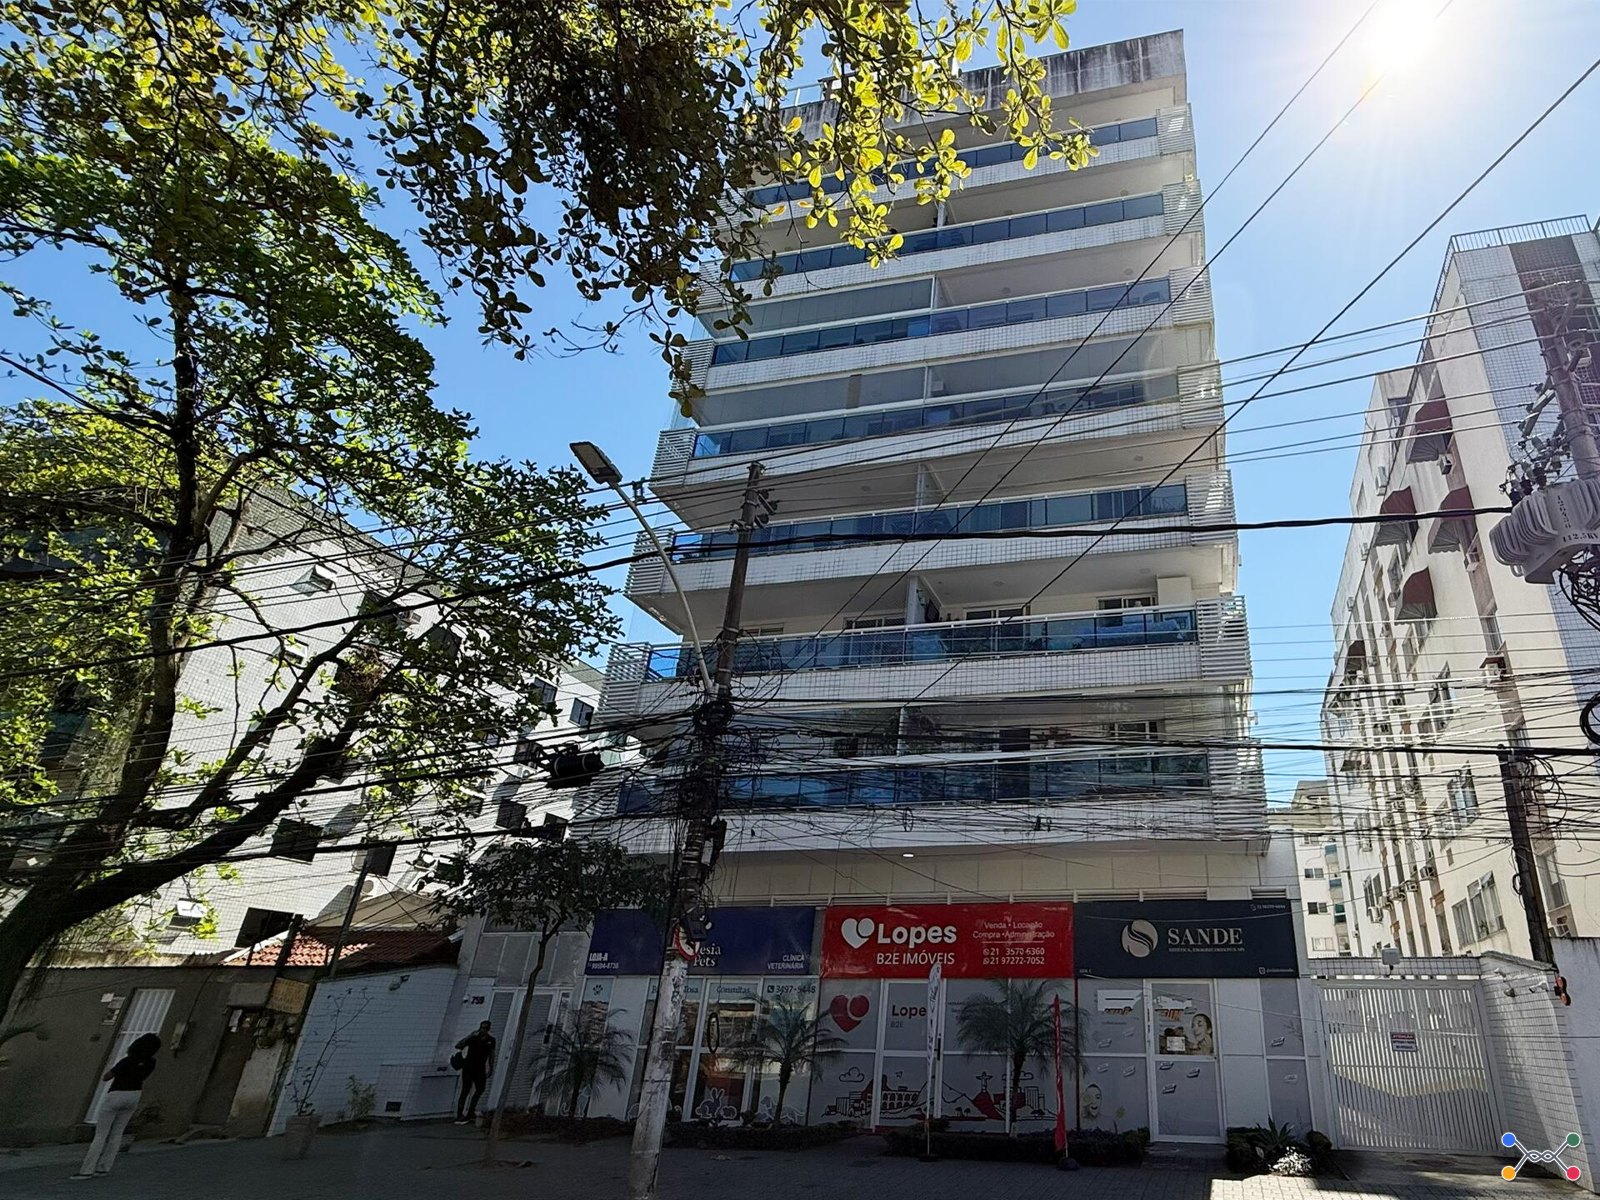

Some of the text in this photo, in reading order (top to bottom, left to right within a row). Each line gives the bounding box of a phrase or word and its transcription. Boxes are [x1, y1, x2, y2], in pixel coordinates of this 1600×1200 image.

[984, 920, 1044, 930] Venda Locação
[877, 923, 957, 949] Lopes
[972, 930, 1001, 940] Compra
[1167, 927, 1244, 946] SANDE
[990, 947, 999, 956] 21
[693, 956, 716, 967] Pets
[782, 954, 805, 962] CLÍNICA
[876, 949, 955, 965] B2E IMÓVEIS
[990, 956, 1045, 965] 21 97272-7052
[767, 961, 804, 970] VETERINÁRIA
[892, 1005, 927, 1019] Lope
